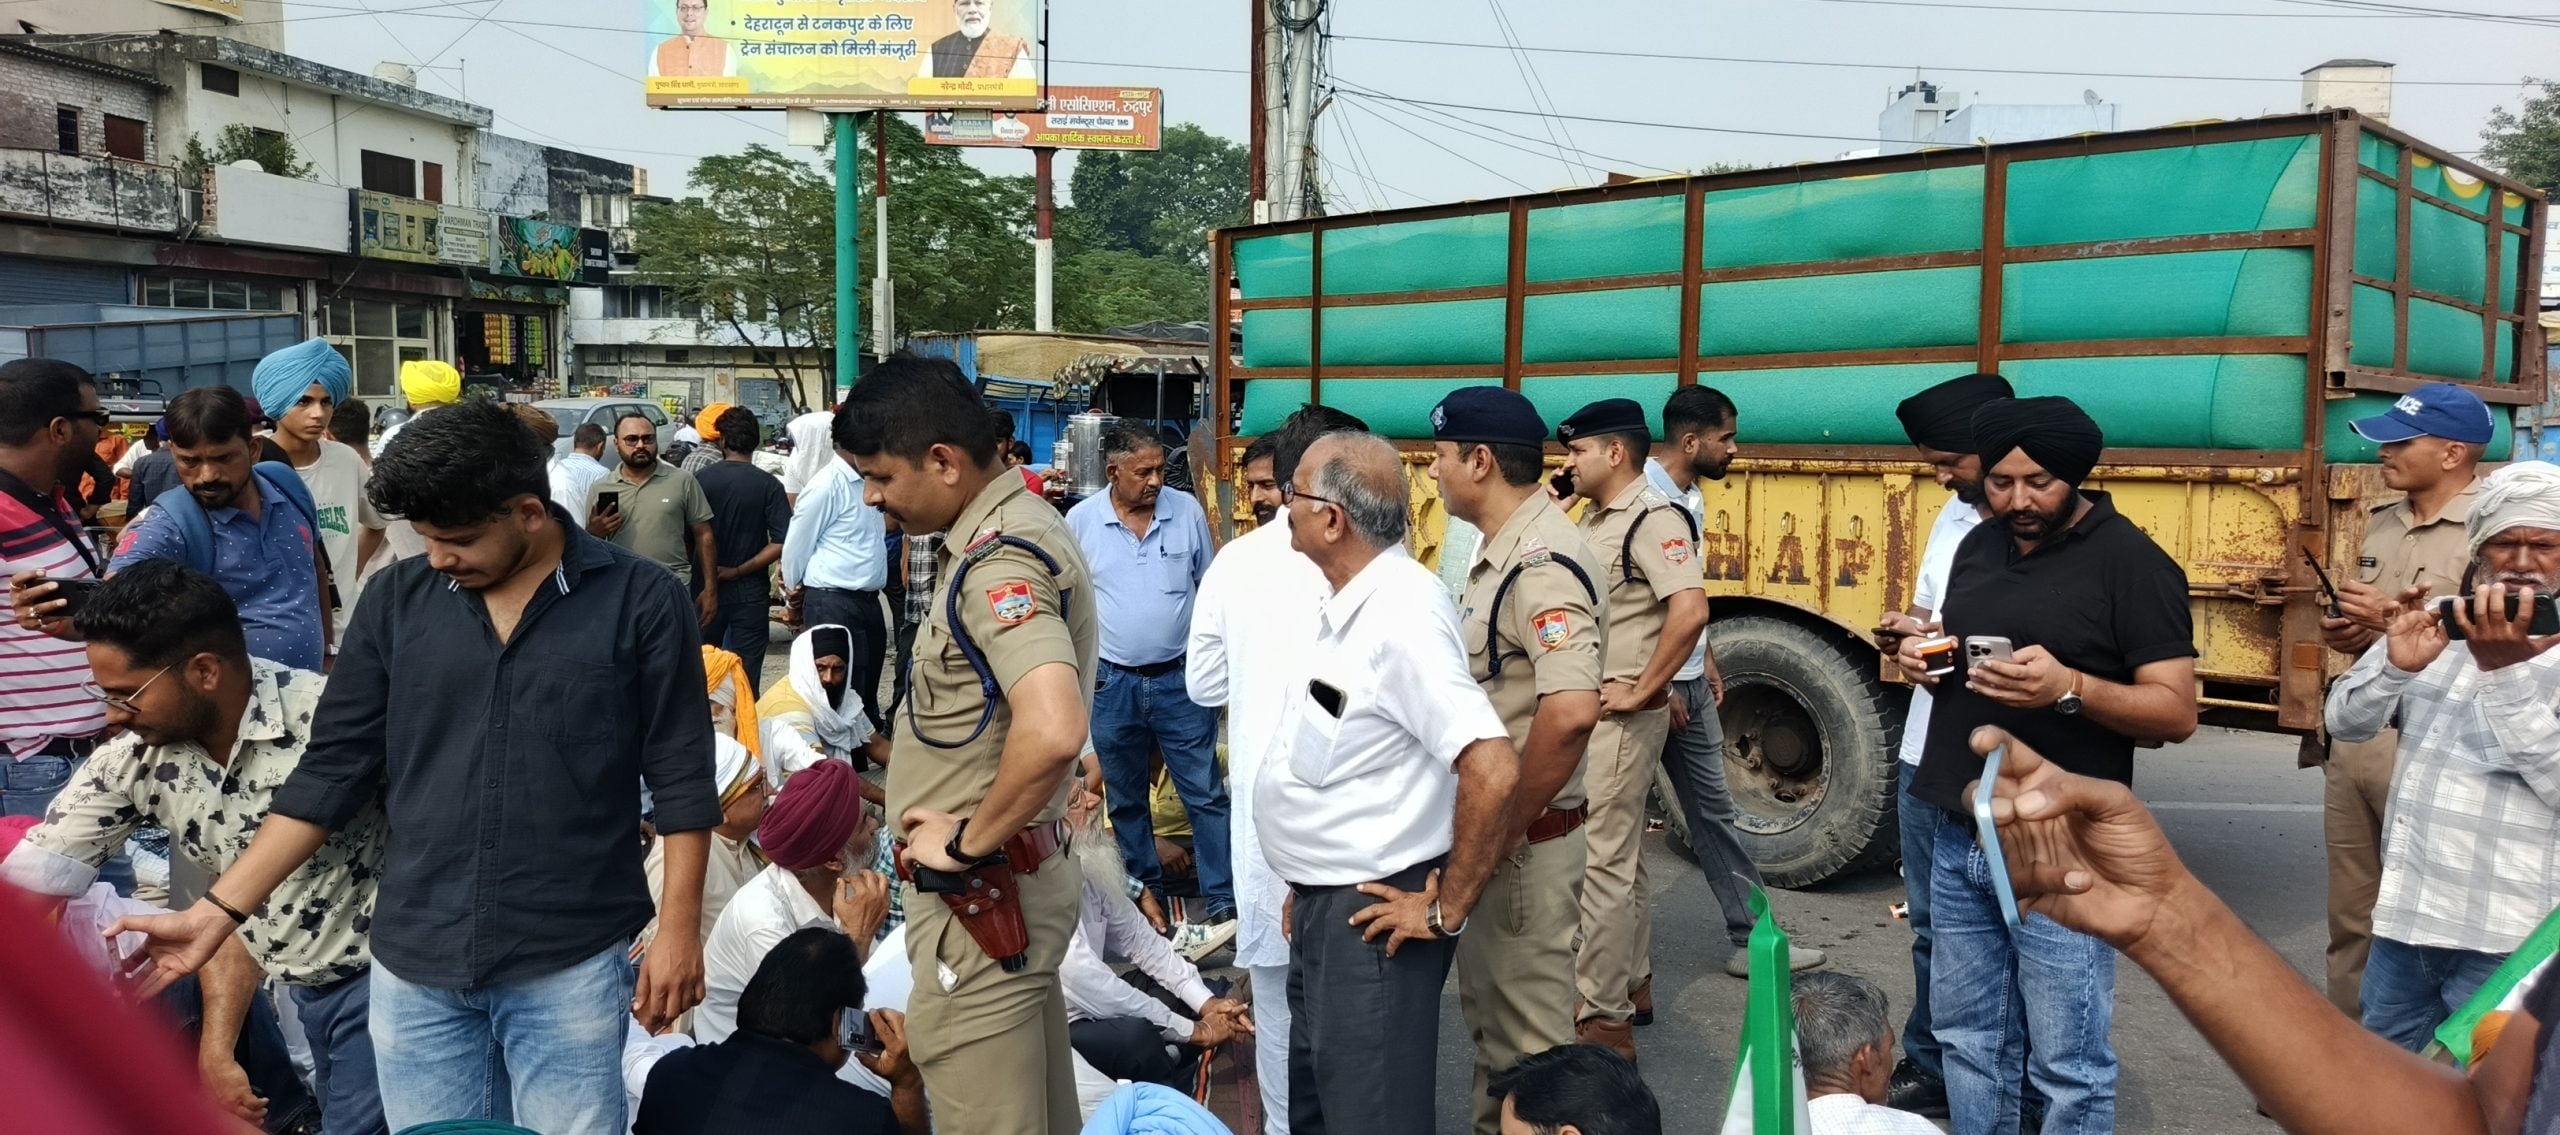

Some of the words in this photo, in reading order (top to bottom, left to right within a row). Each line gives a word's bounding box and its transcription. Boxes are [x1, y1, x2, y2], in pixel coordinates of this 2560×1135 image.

[744, 14, 794, 36] देहरादून
[797, 14, 809, 30] से
[812, 16, 865, 35] टनकपुर
[868, 14, 882, 30] के
[885, 13, 913, 31] लिए
[740, 39, 761, 56] ट्रेन
[765, 39, 817, 56] संचालन
[820, 39, 838, 56] को
[841, 39, 876, 56] मिली
[879, 40, 917, 60] मंजूरी
[1035, 132, 1060, 142] आपका
[1087, 133, 1112, 144] स्वागत
